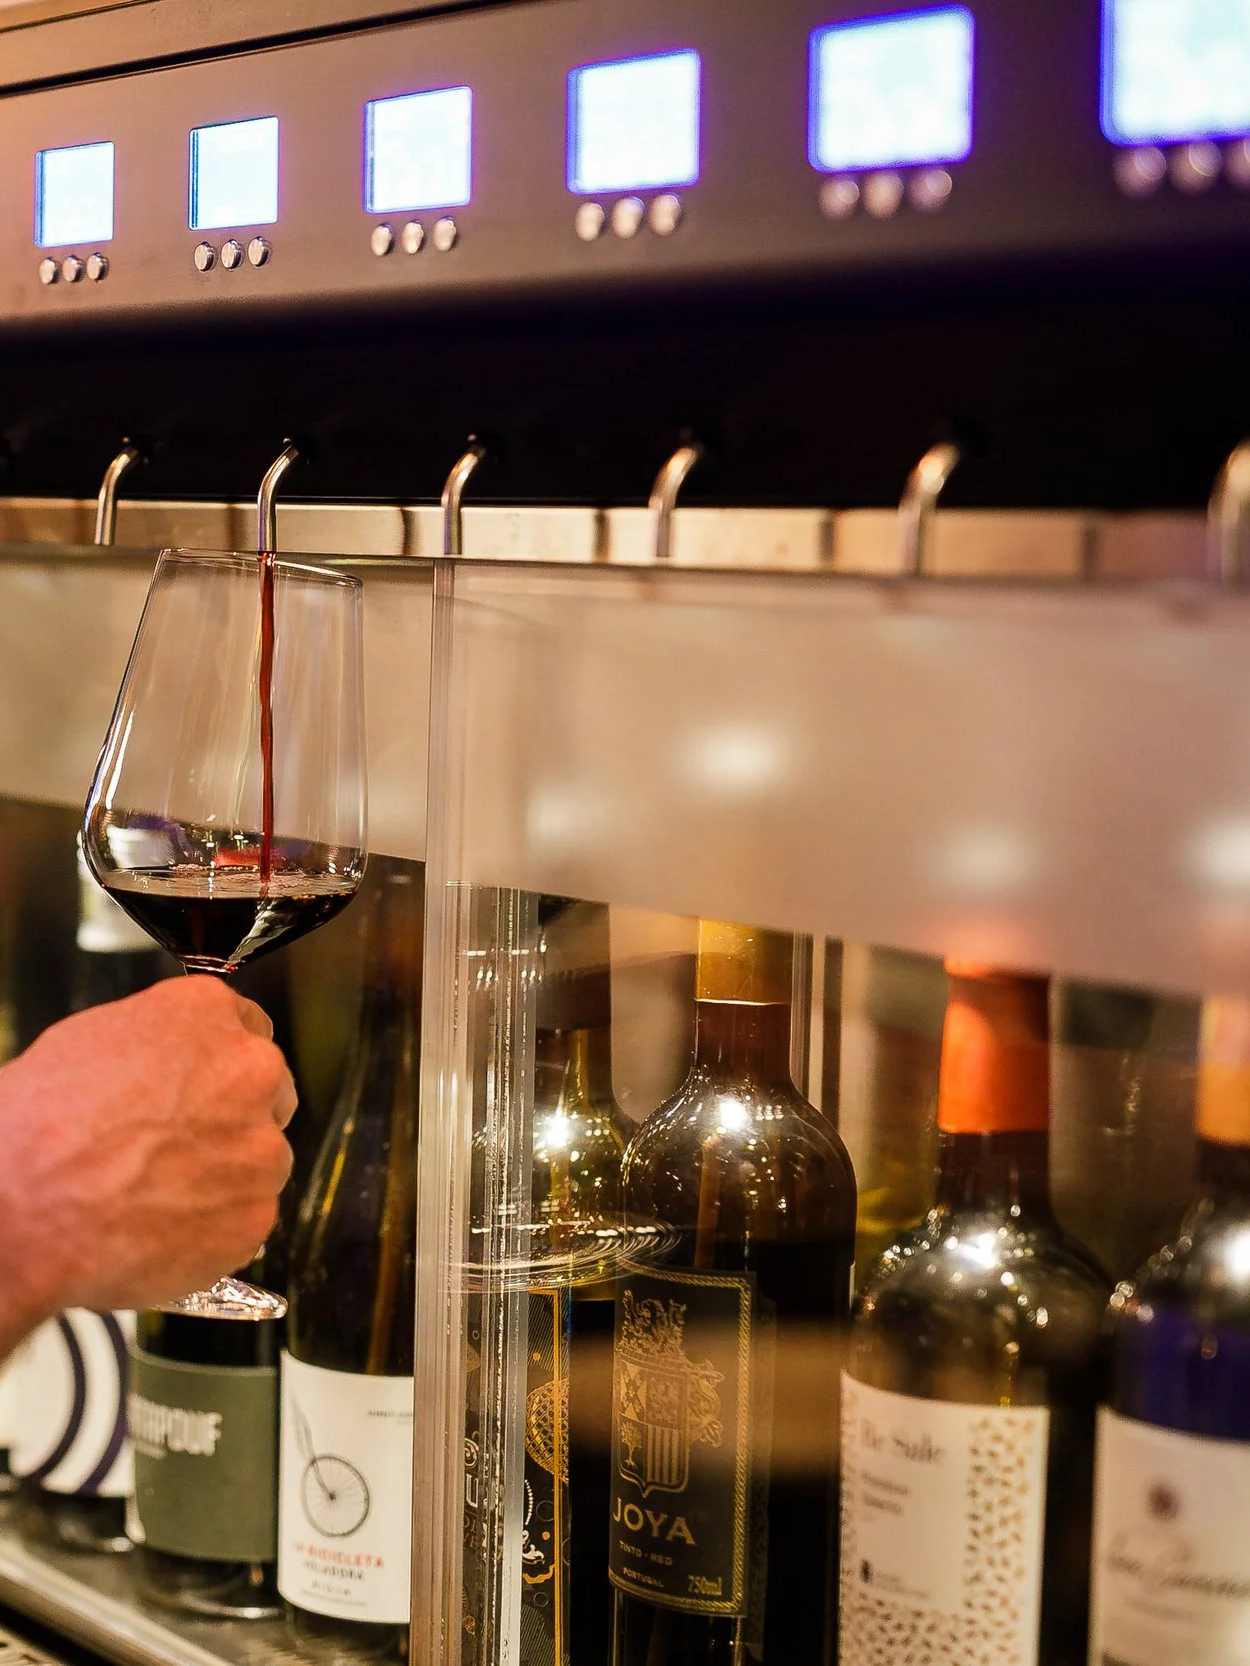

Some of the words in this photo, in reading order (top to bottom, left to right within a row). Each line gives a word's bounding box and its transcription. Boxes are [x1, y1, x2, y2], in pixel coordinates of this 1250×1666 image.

[612, 1496, 696, 1546] JOYA
[307, 1544, 385, 1568] BICICLETA
[618, 1539, 643, 1558] TINTO
[622, 1566, 665, 1588] PORTUGAL
